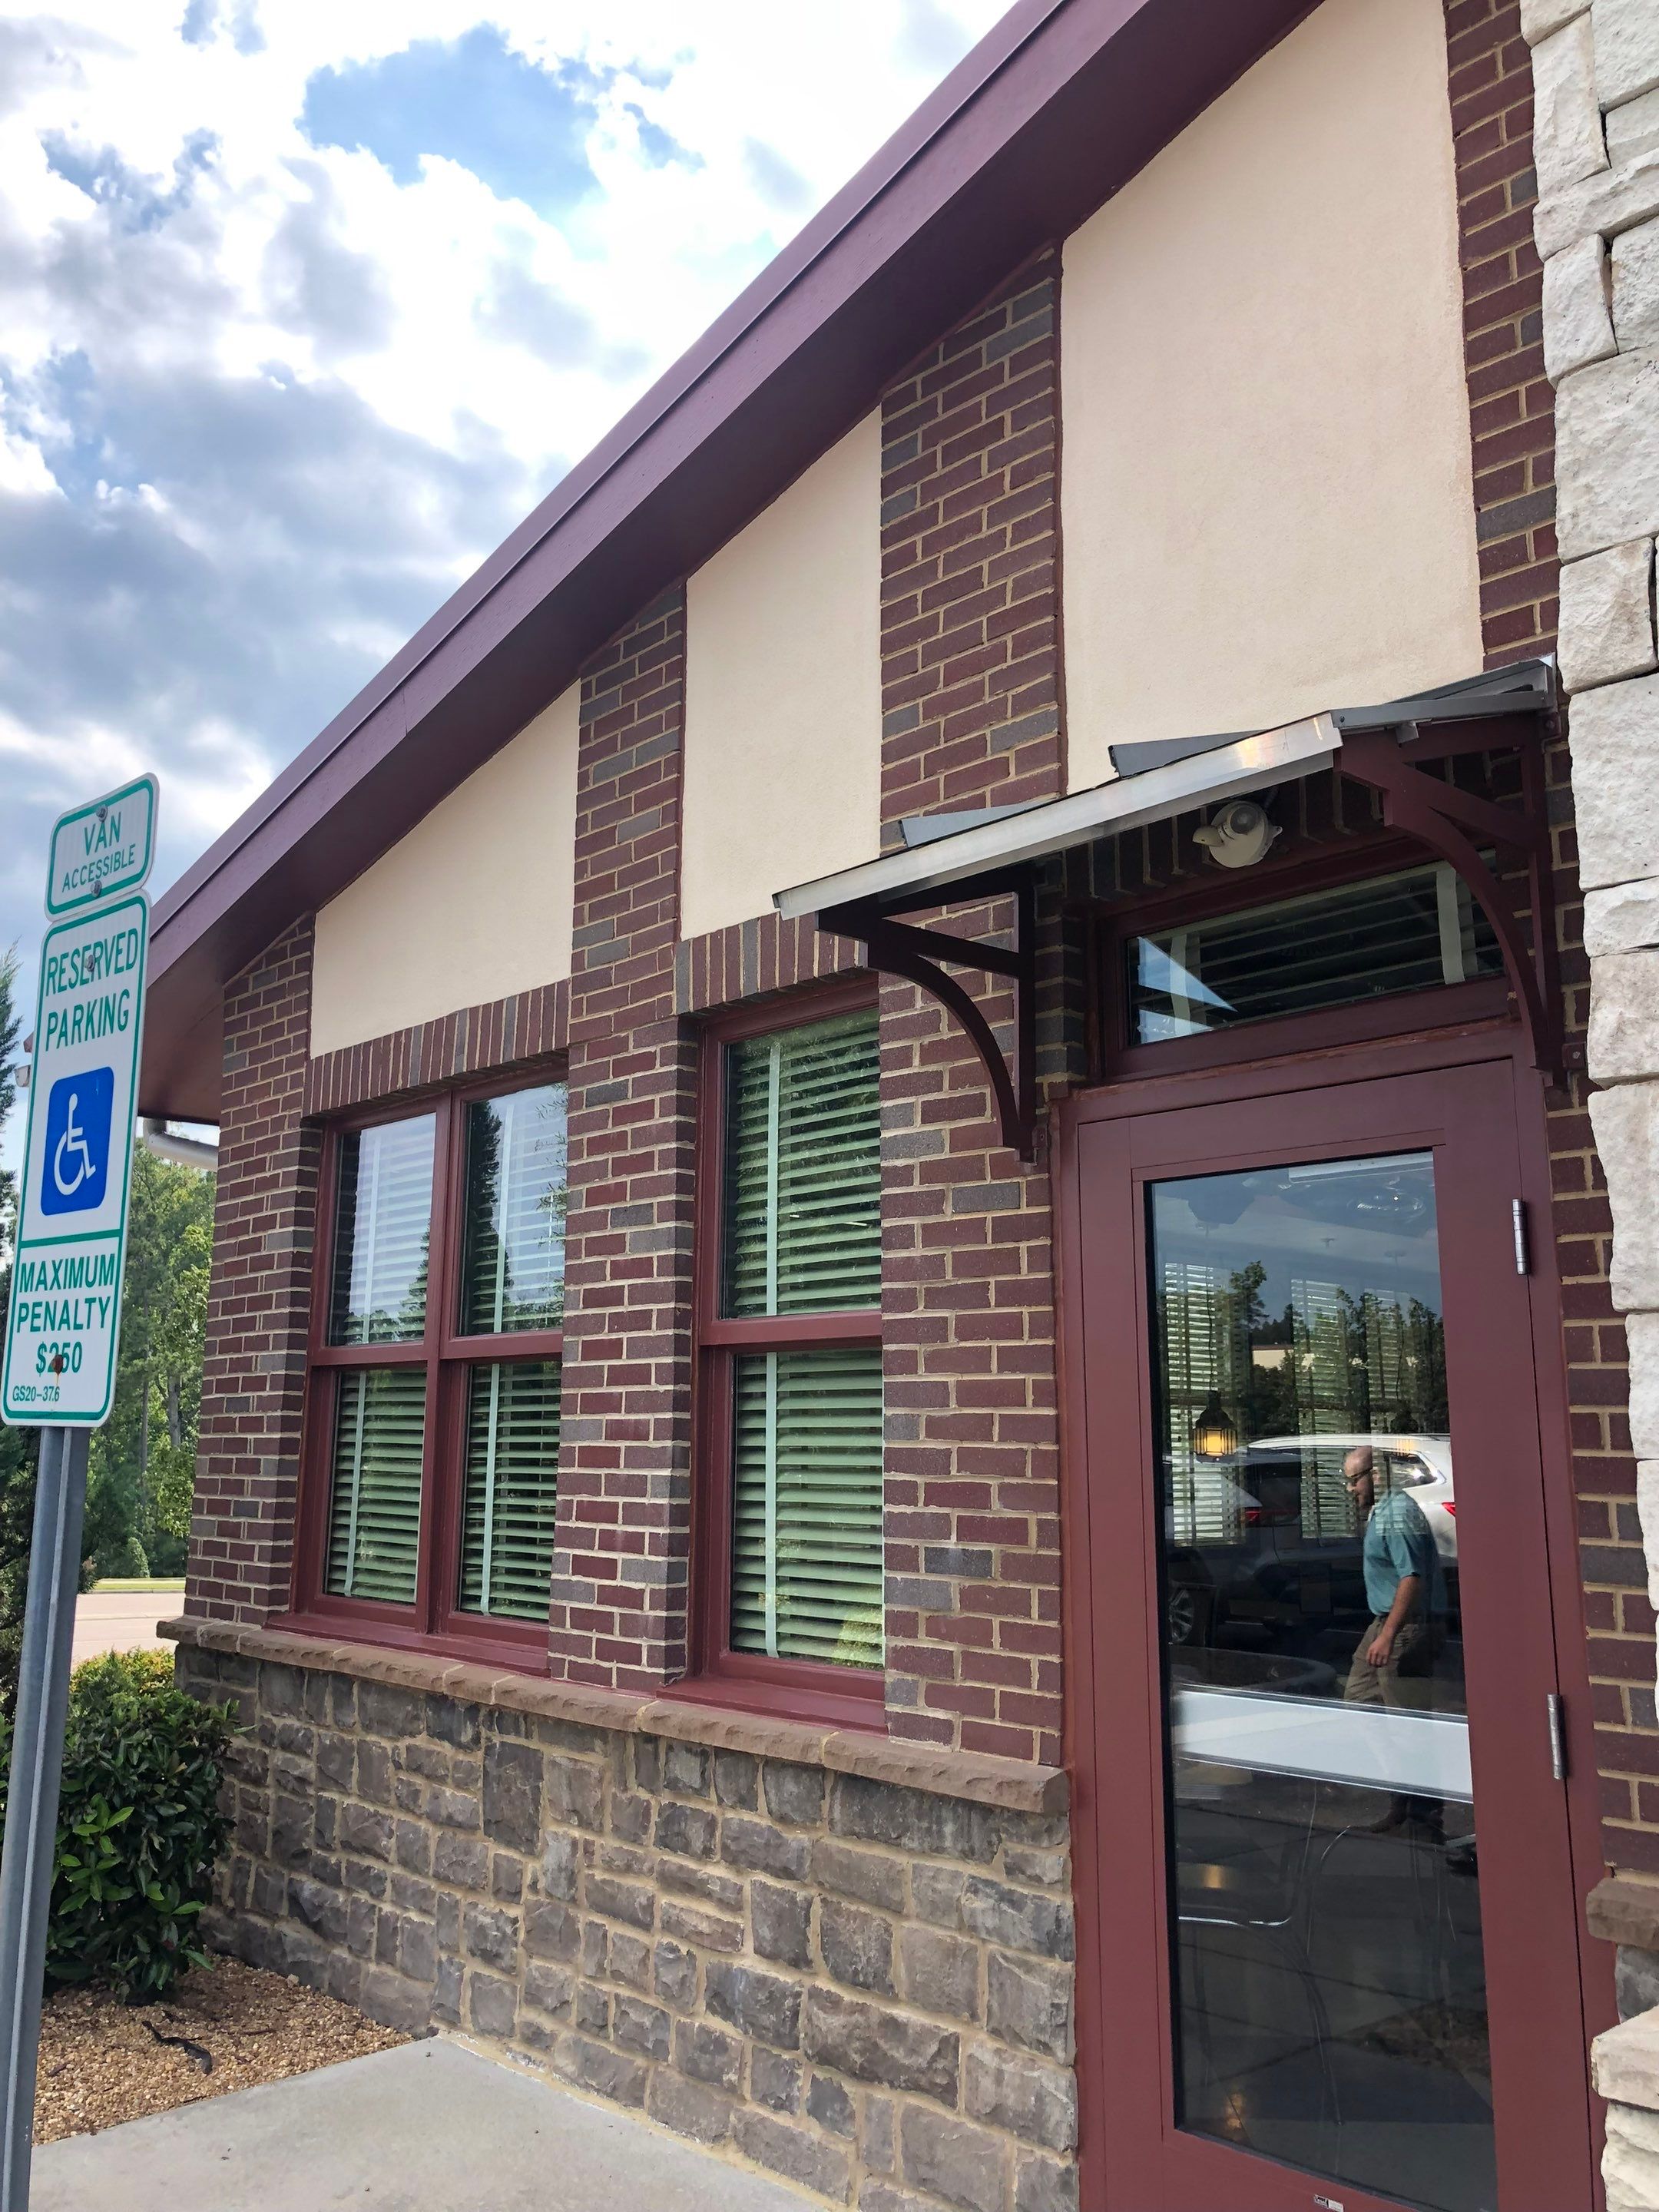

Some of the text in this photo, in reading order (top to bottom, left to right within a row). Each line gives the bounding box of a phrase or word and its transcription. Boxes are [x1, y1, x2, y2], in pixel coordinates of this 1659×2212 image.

[84, 812, 121, 856] VAN
[61, 843, 136, 892] ACCESSIBLE
[45, 928, 138, 997] RESERVED
[45, 988, 130, 1051] PARKING
[19, 1253, 115, 1293] MAXIMUM
[17, 1296, 111, 1333] PENALTY
